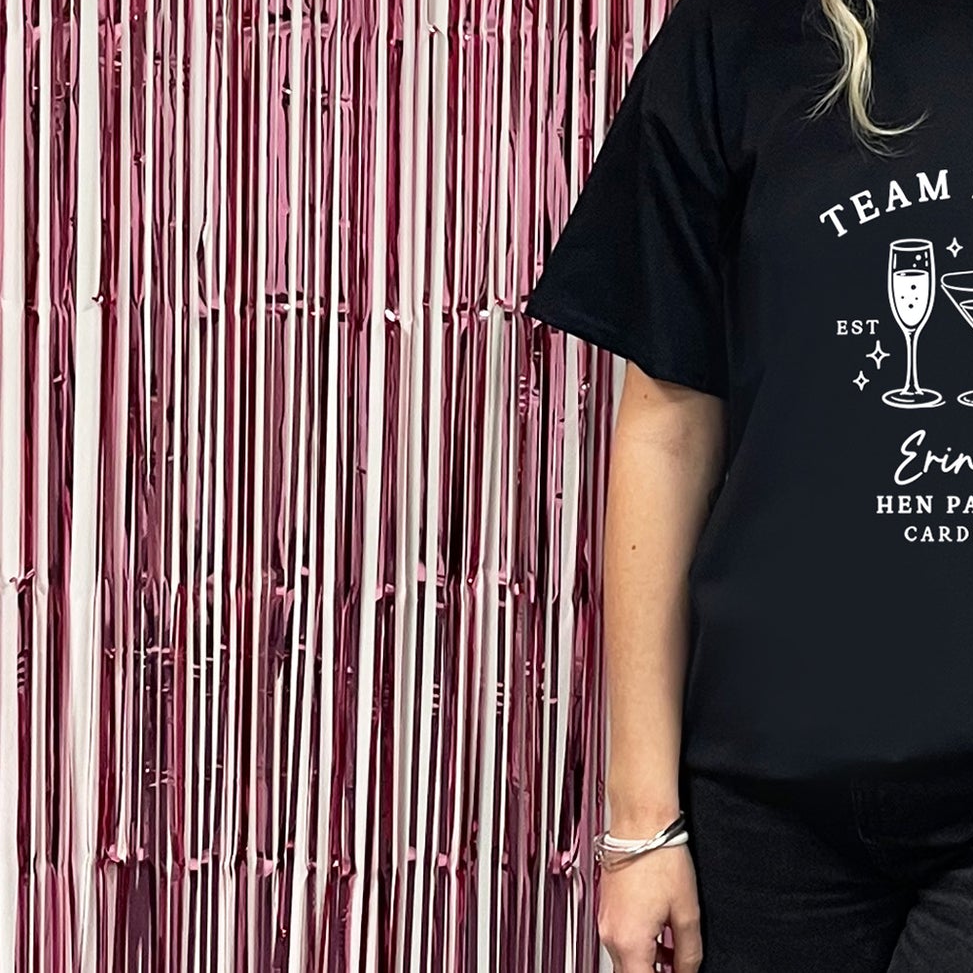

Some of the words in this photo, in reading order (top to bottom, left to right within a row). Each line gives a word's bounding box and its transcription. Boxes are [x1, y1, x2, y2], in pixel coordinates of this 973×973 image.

[819, 168, 951, 238] TEAM
[836, 319, 880, 336] EST
[876, 494, 934, 514] HEN
